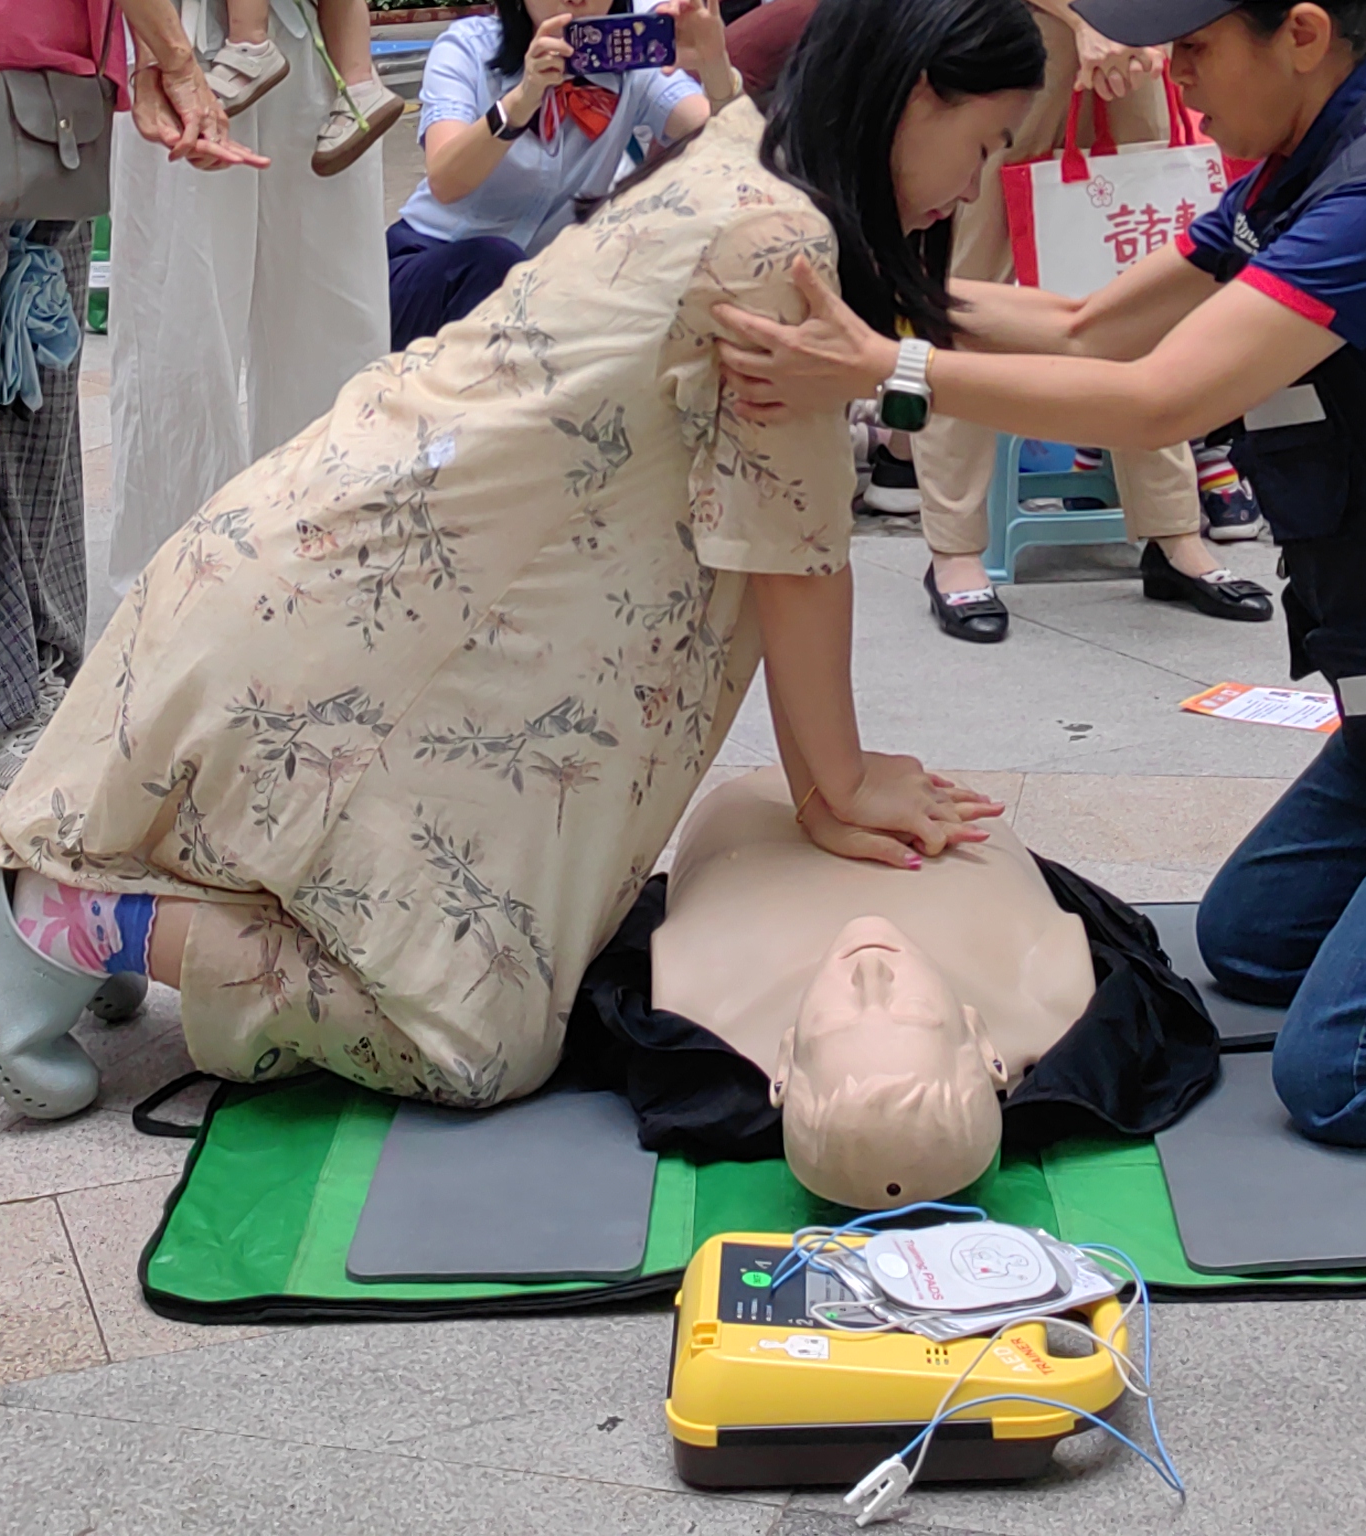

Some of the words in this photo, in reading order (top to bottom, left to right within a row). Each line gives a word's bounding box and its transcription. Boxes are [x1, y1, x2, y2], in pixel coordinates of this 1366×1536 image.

[922, 1271, 945, 1301] PADS
[993, 1346, 1033, 1372] AED
[1010, 1336, 1055, 1376] TRAINER
